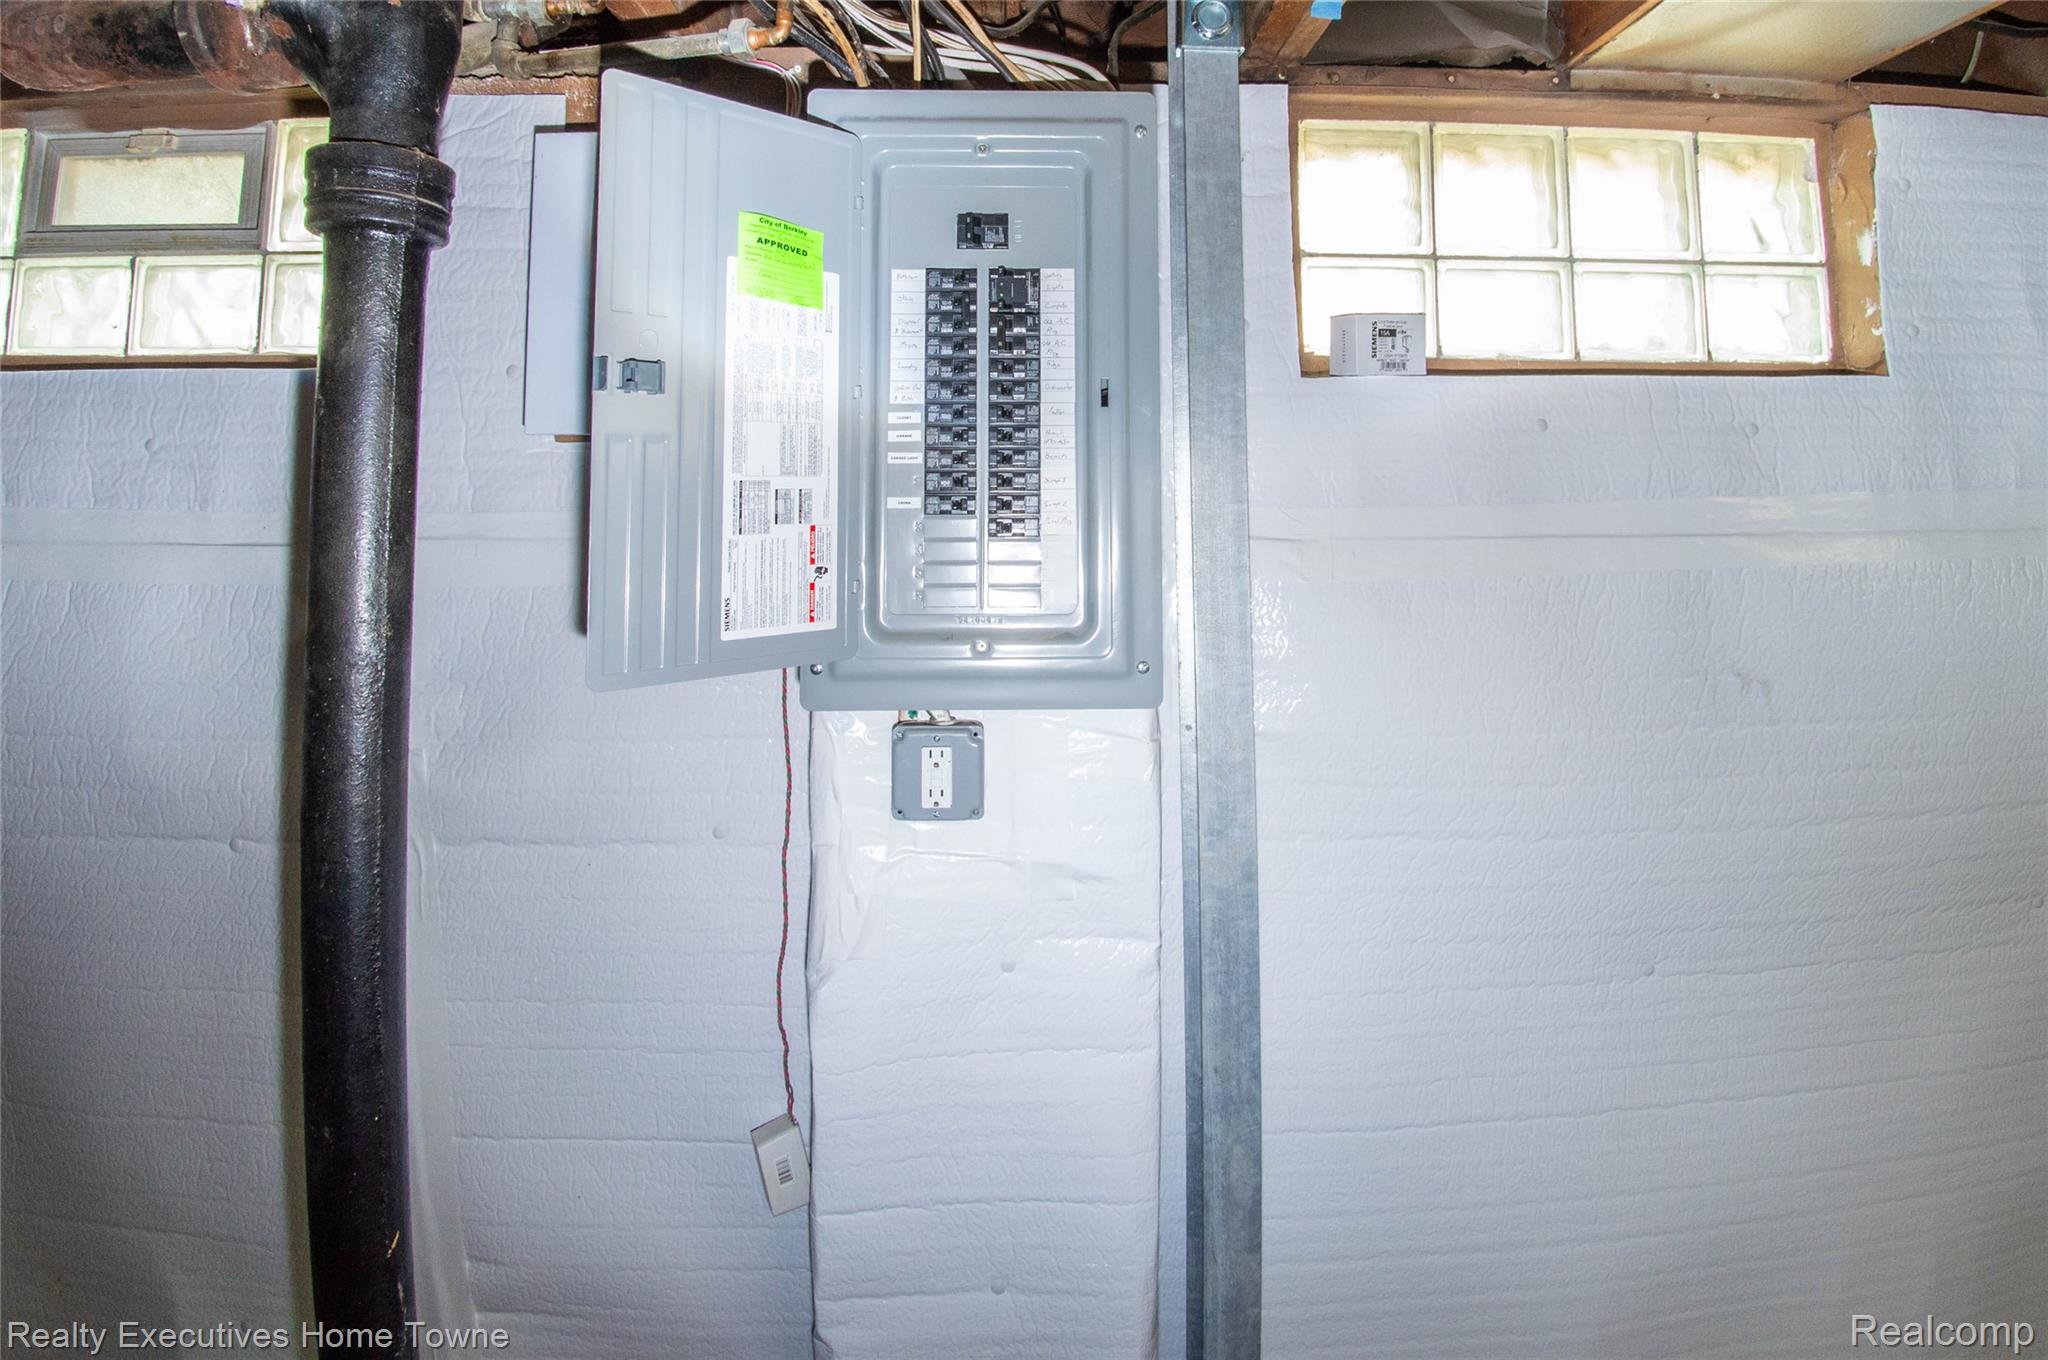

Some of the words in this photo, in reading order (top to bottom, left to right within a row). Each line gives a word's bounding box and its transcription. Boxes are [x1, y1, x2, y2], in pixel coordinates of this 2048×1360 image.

[759, 217, 773, 227] City
[756, 237, 809, 257] APPROVED
[723, 597, 731, 632] SIEMENS
